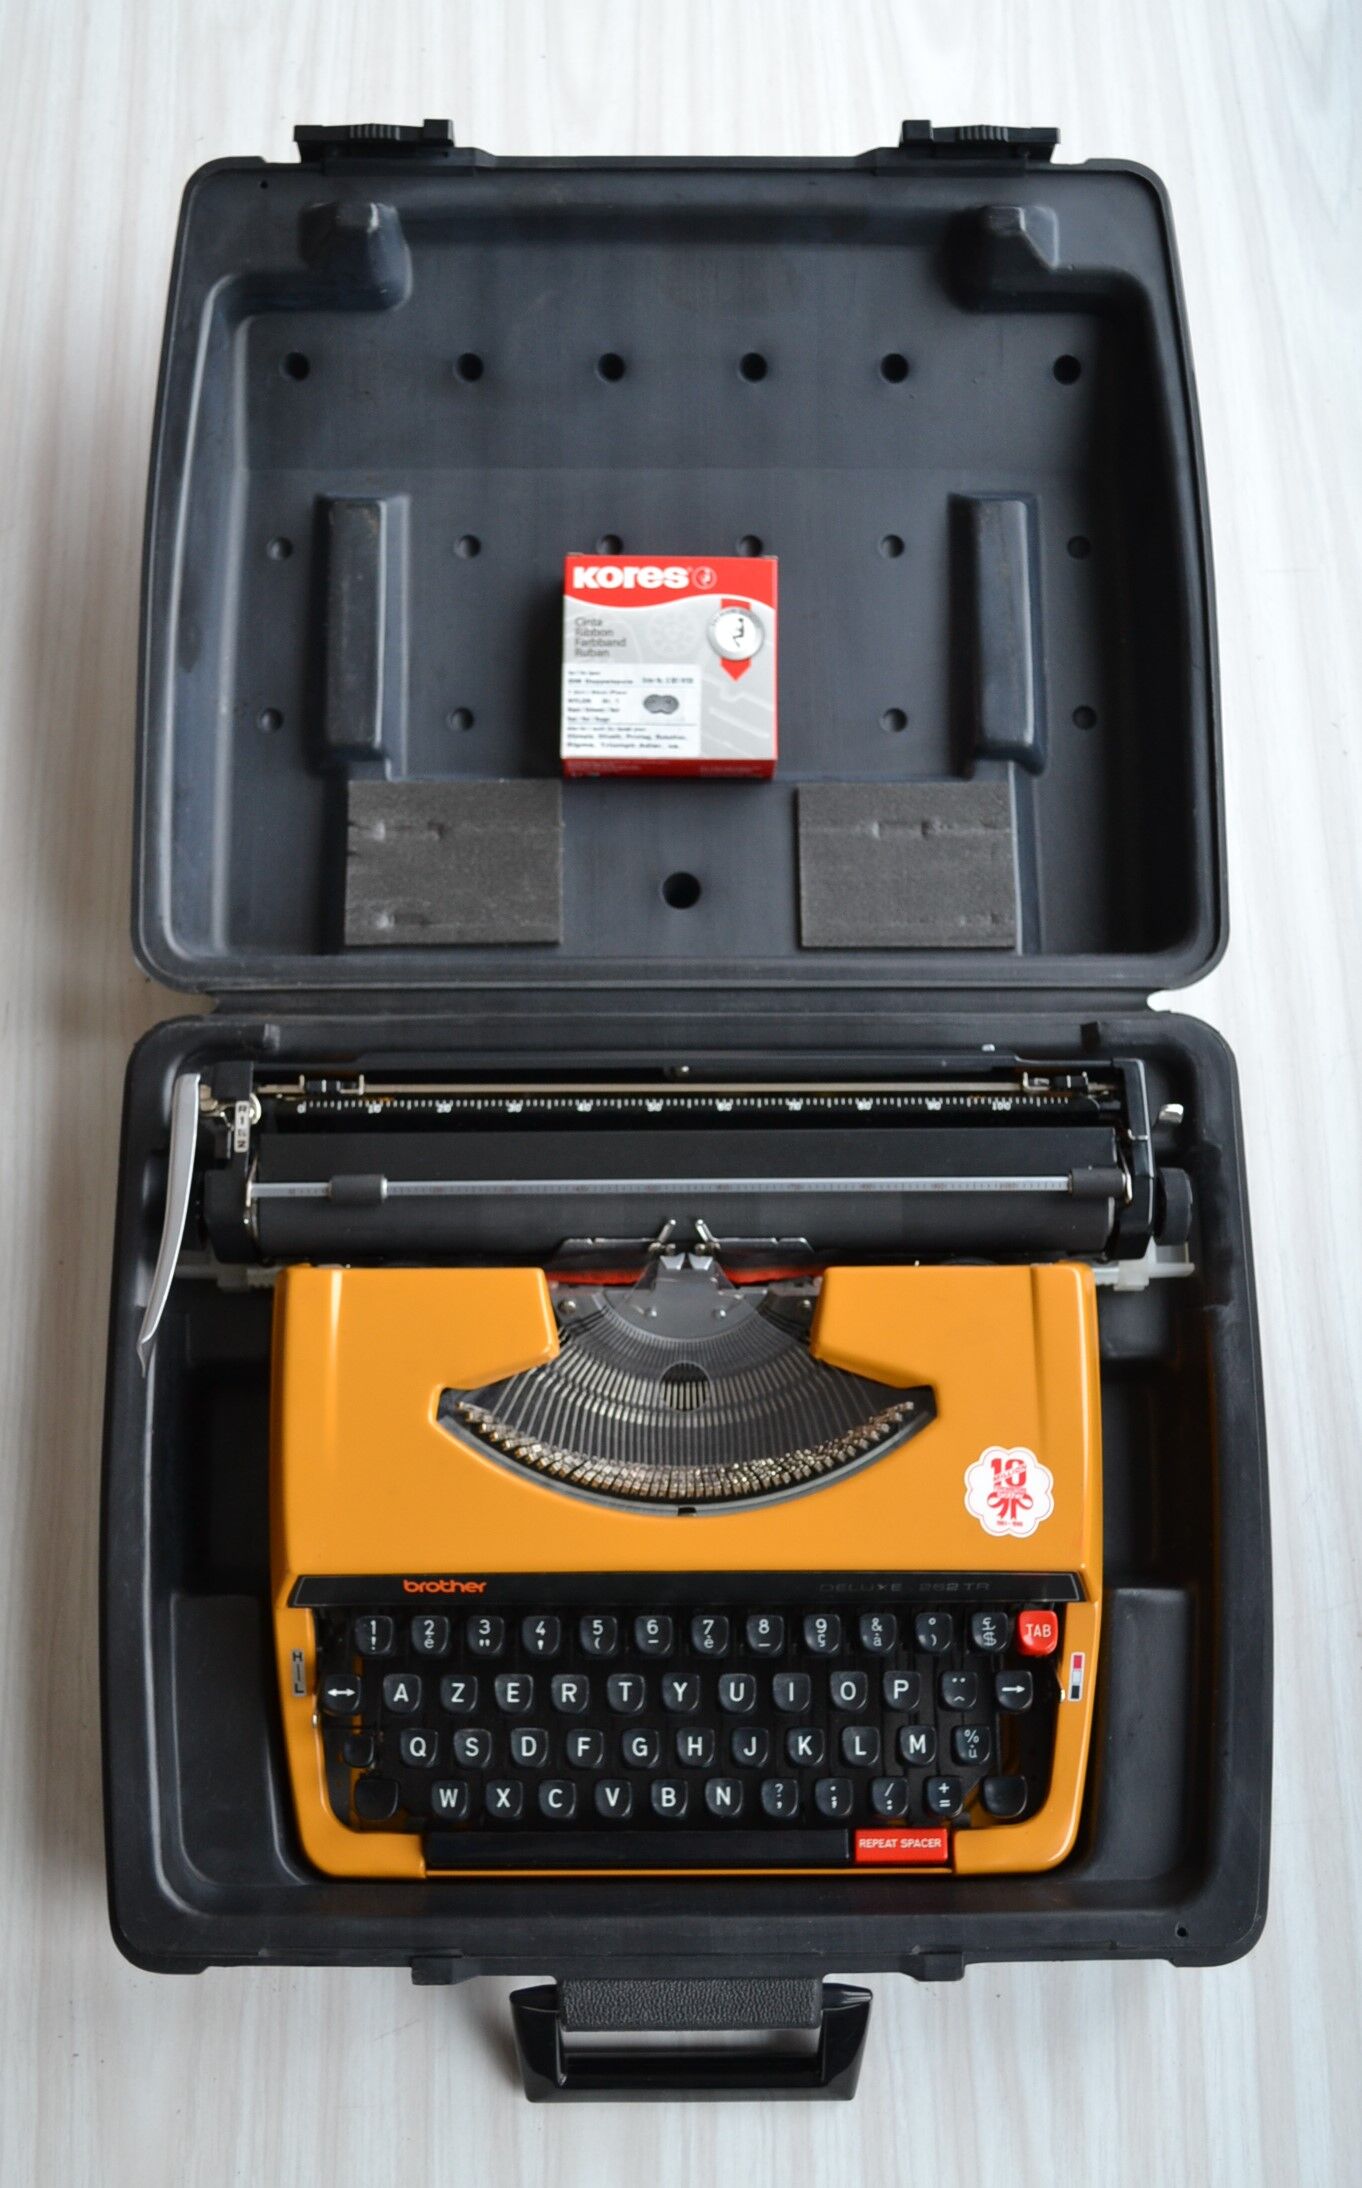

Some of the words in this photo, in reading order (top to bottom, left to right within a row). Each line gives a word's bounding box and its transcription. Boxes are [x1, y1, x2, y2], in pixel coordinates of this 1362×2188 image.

[402, 1579, 488, 1594] brother
[424, 1619, 434, 1636] 2
[479, 1619, 490, 1634] 3
[536, 1620, 545, 1635] 4
[593, 1619, 603, 1635] 5
[647, 1619, 658, 1634] 6
[703, 1619, 714, 1634] 7
[759, 1618, 769, 1634] 8
[816, 1618, 827, 1633] 9
[872, 1617, 882, 1631] &
[1024, 1622, 1052, 1638] TAB
[394, 1683, 408, 1701] A
[452, 1682, 465, 1702] Z
[507, 1682, 519, 1702] E
[562, 1682, 577, 1702] R
[619, 1681, 632, 1701] T
[673, 1681, 687, 1701] Y
[730, 1681, 744, 1701] U
[841, 1681, 856, 1700] O
[894, 1679, 908, 1699] P
[410, 1736, 425, 1756] Q
[466, 1736, 478, 1756] S
[522, 1735, 536, 1756] D
[578, 1736, 590, 1756] F
[632, 1737, 647, 1756] G
[688, 1736, 702, 1756] H
[744, 1736, 756, 1756] J
[799, 1735, 811, 1755] K
[855, 1735, 866, 1755] L
[910, 1734, 925, 1753] M
[440, 1788, 457, 1807] W
[497, 1788, 510, 1807] X
[549, 1788, 562, 1808] C
[606, 1787, 619, 1806] V
[662, 1787, 675, 1807] B
[717, 1786, 730, 1805] N
[859, 1838, 898, 1849] REPEAT
[900, 1838, 942, 1849] SPACER
